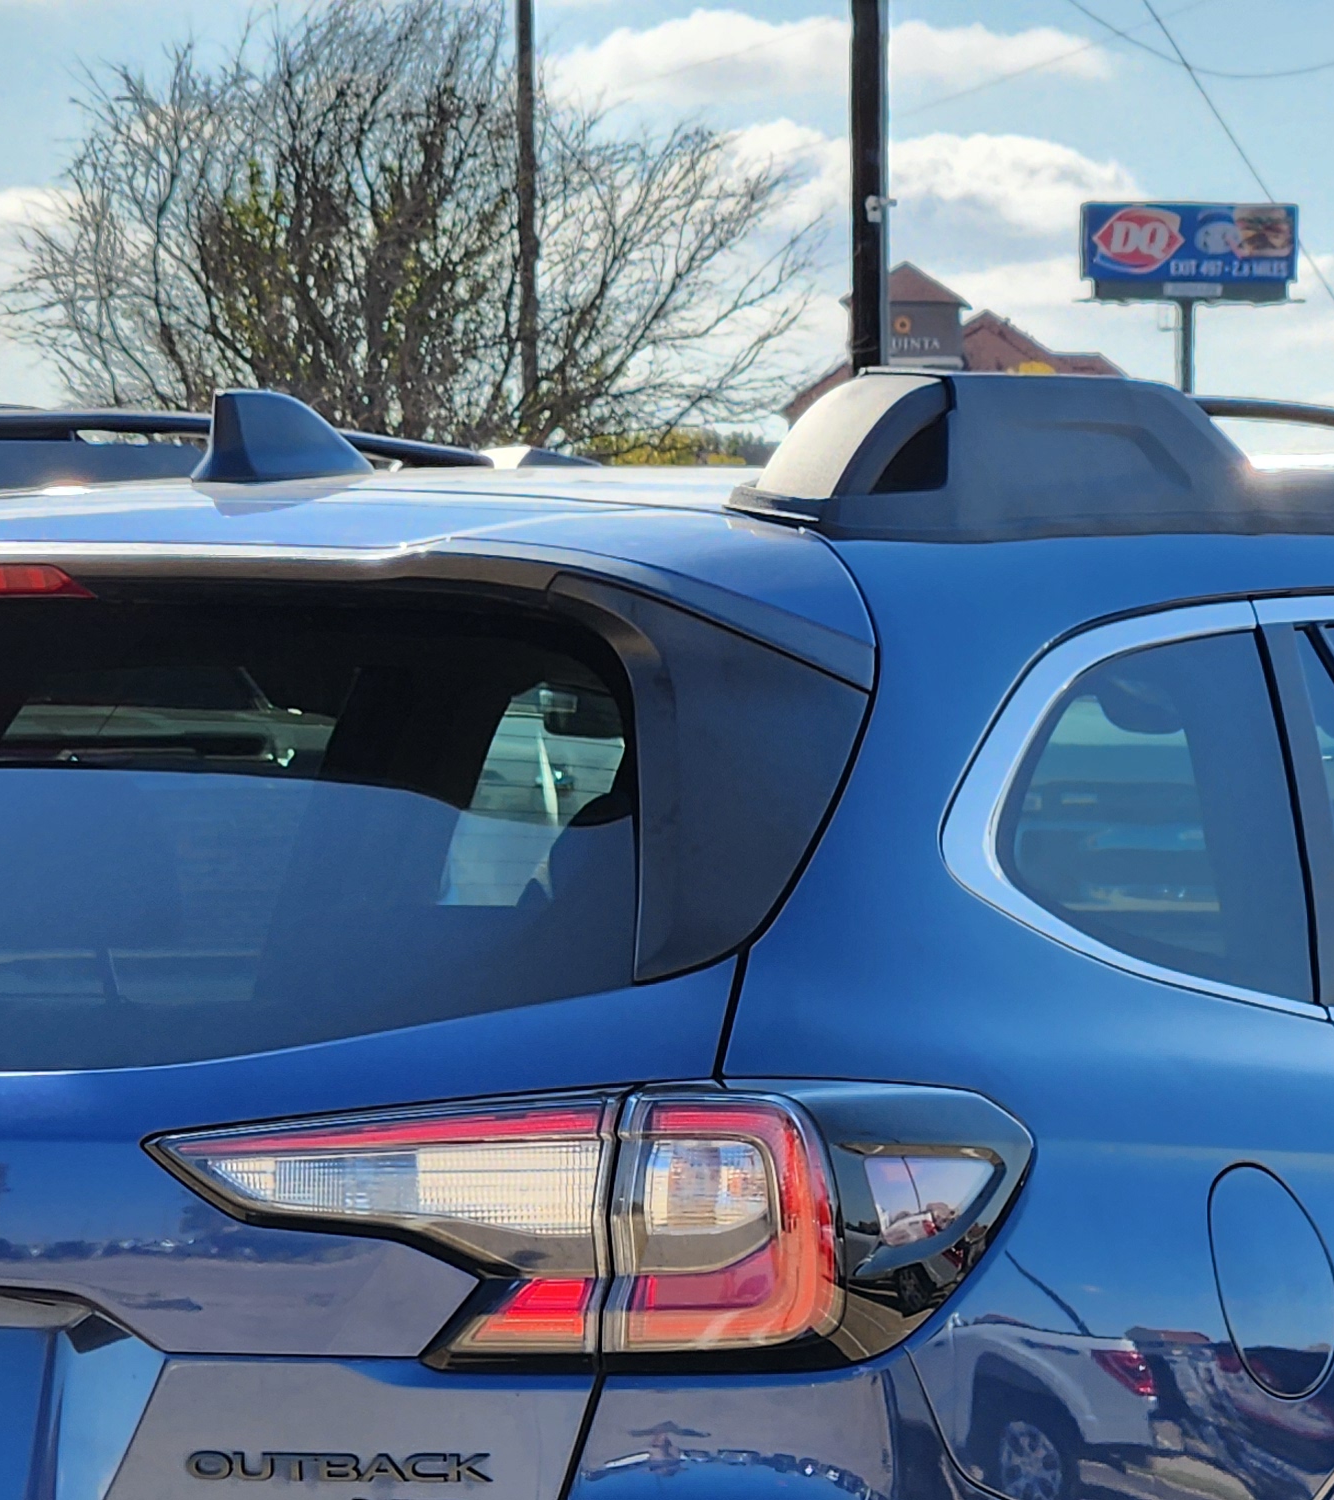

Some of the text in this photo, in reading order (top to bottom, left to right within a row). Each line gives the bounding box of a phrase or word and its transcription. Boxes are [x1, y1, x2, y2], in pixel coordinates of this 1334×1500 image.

[1111, 221, 1171, 258] DQ
[1169, 259, 1197, 276] EXIT
[185, 1450, 493, 1483] OUTBACK
